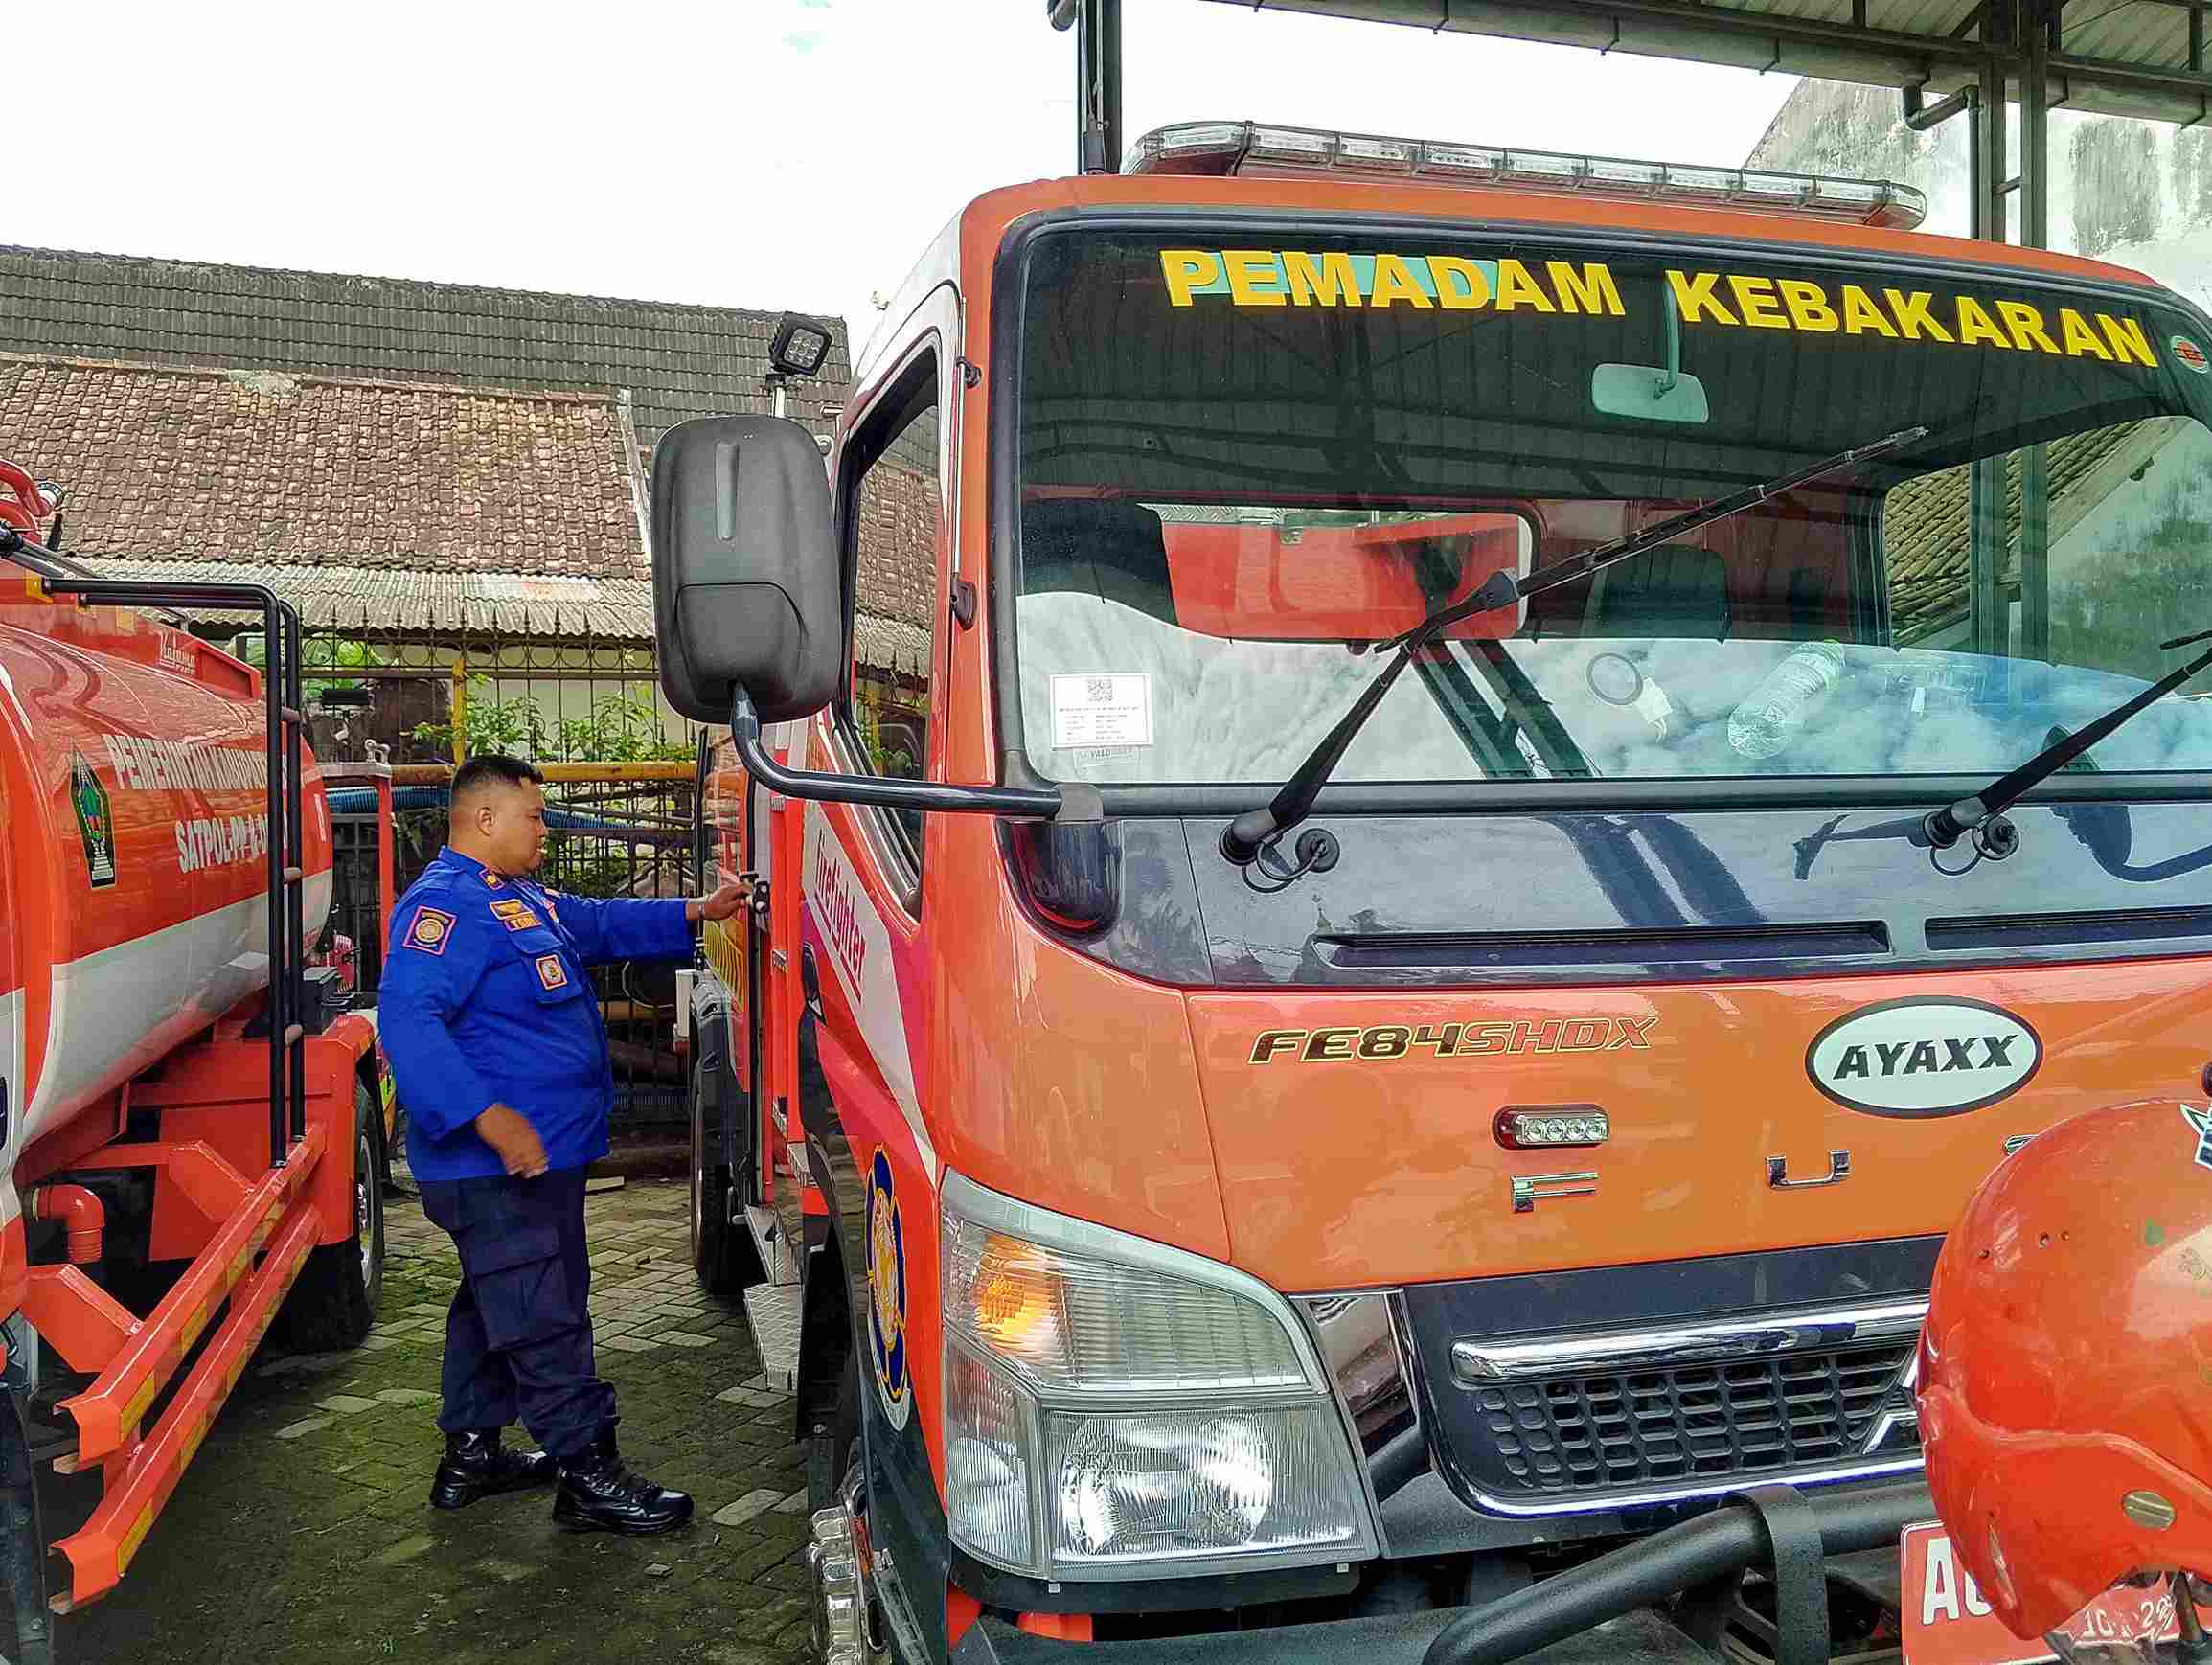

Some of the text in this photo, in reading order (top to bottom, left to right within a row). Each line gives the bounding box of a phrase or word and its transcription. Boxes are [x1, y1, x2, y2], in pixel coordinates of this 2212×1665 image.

[1159, 250, 1626, 316] PEMADAM
[1665, 269, 2159, 368] KEBAKARAN
[102, 733, 217, 790] PEMERINTAH
[175, 817, 230, 874] SATPOL
[815, 828, 866, 981] firefighter
[1247, 1017, 1657, 1065] FE84SHDX
[1833, 1034, 2018, 1081] AYAXX
